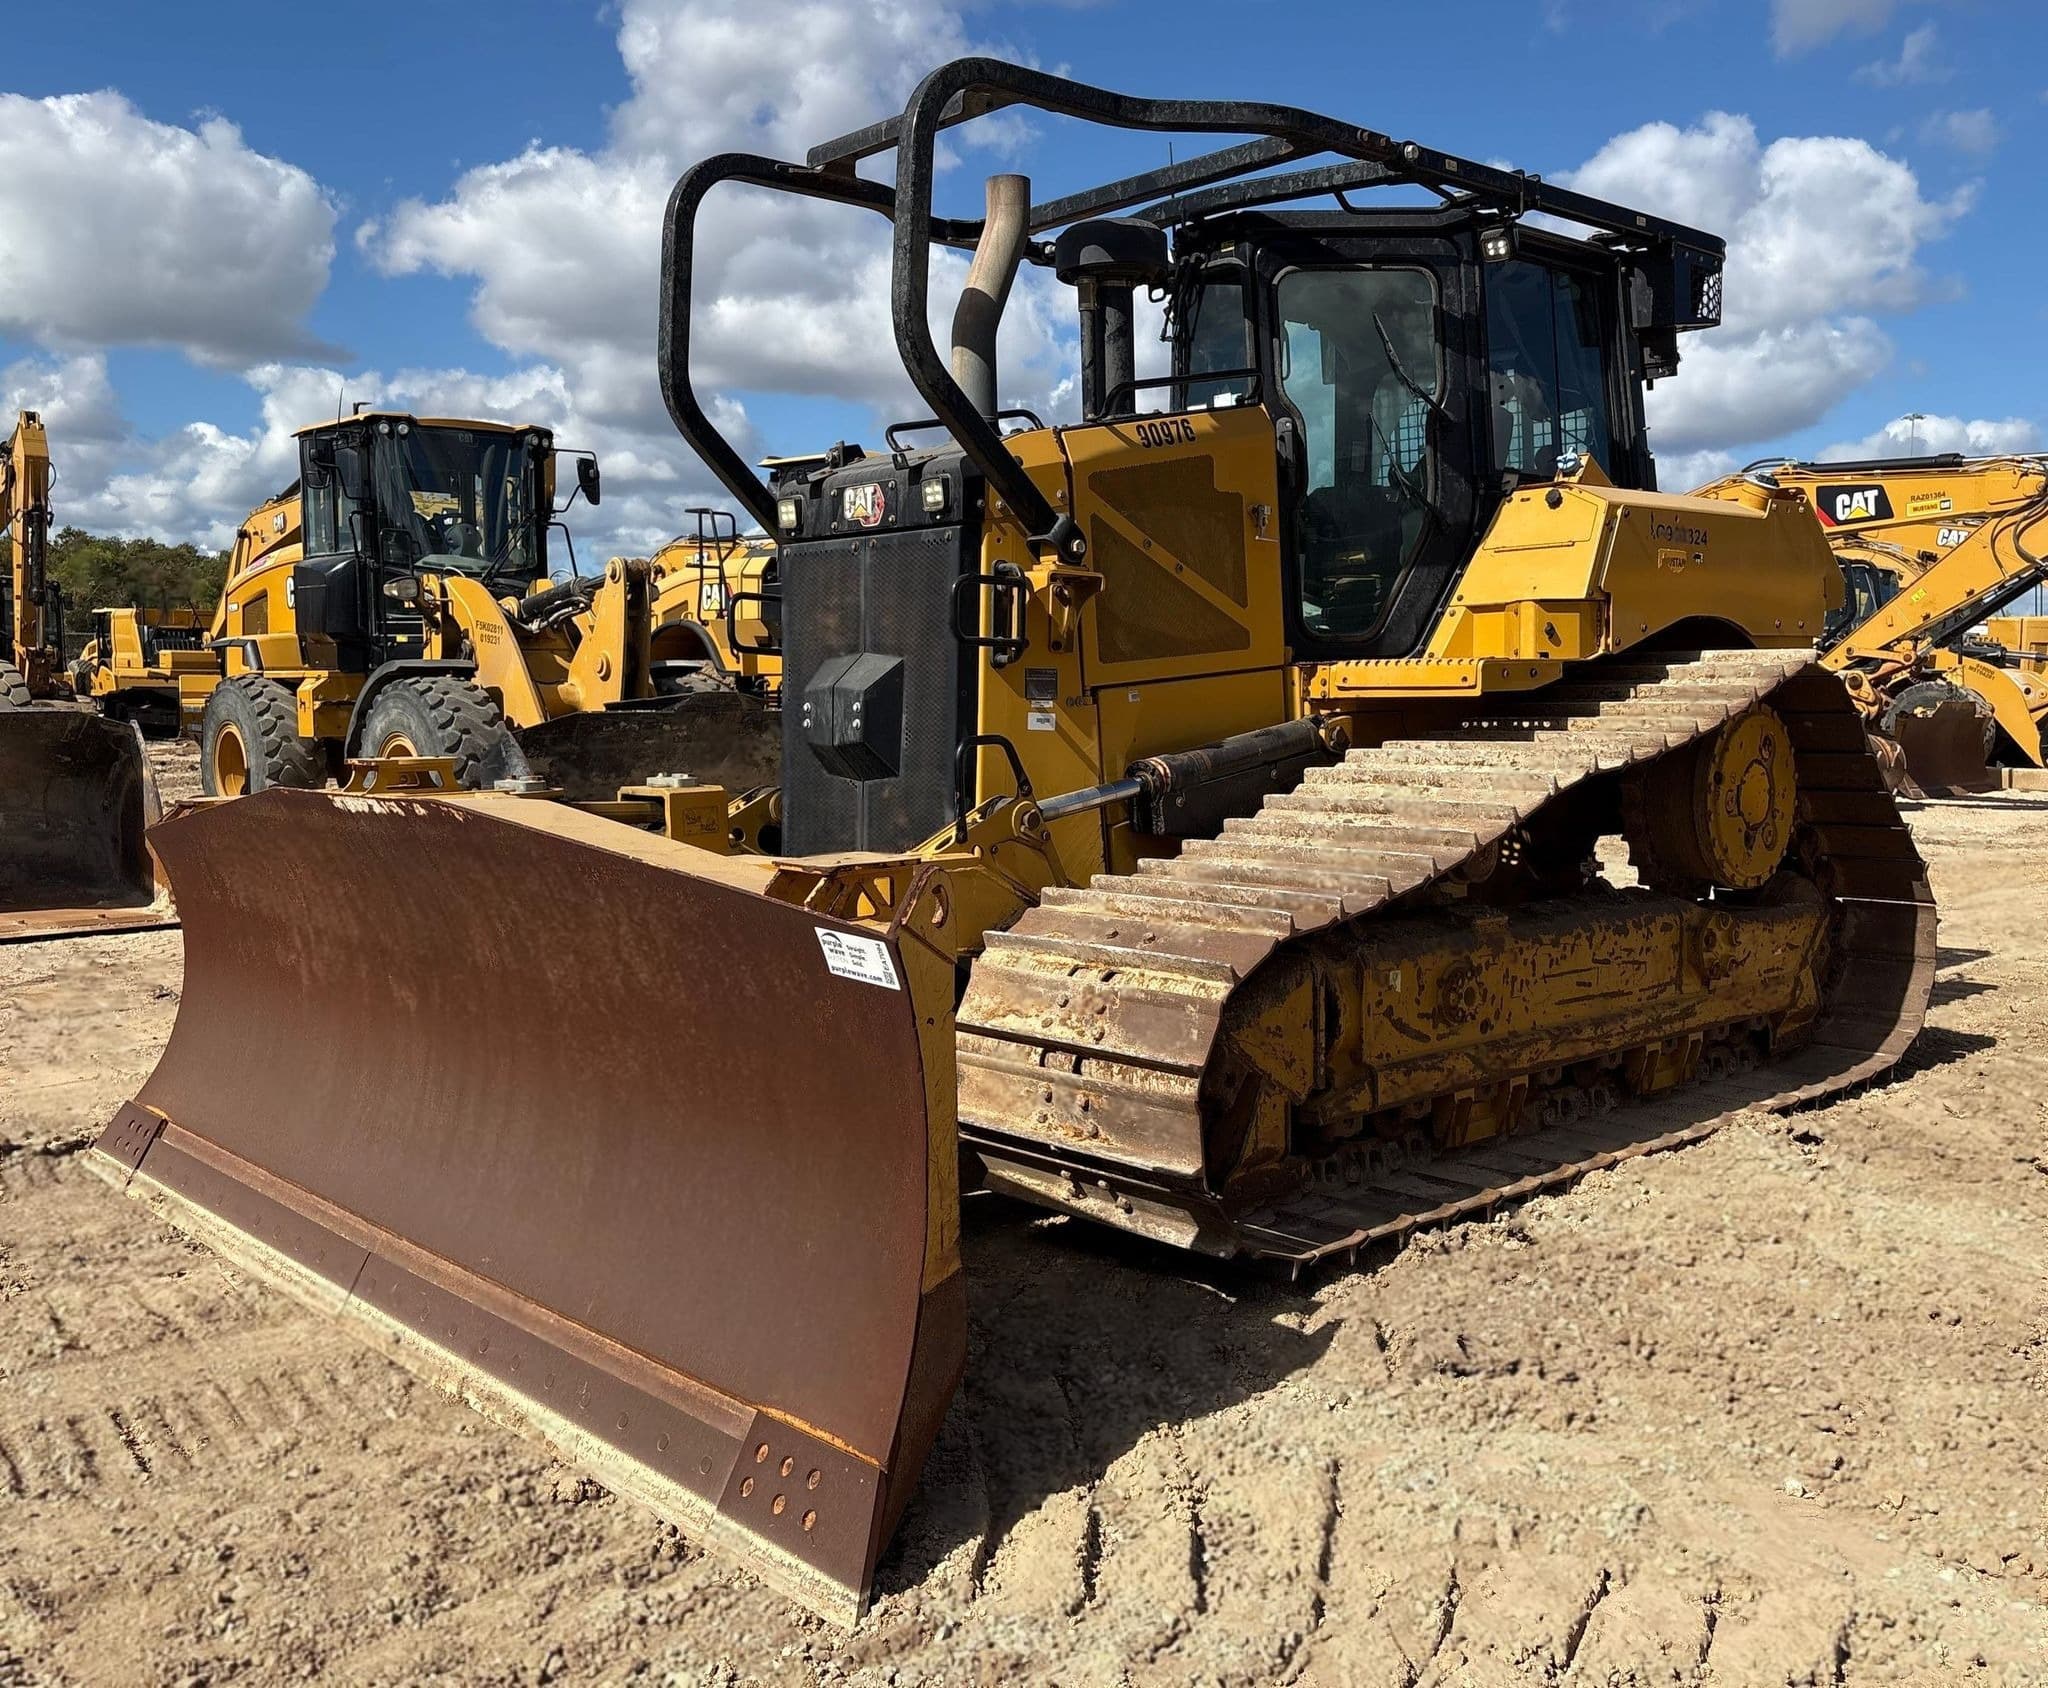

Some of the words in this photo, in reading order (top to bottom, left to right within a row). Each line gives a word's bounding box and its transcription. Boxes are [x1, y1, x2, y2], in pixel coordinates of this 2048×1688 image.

[1136, 419, 1196, 448] 90976
[843, 486, 875, 519] CAT
[1835, 489, 1879, 520] CAT
[1937, 528, 1969, 546] CAT
[831, 965, 883, 982] purplewave.com
